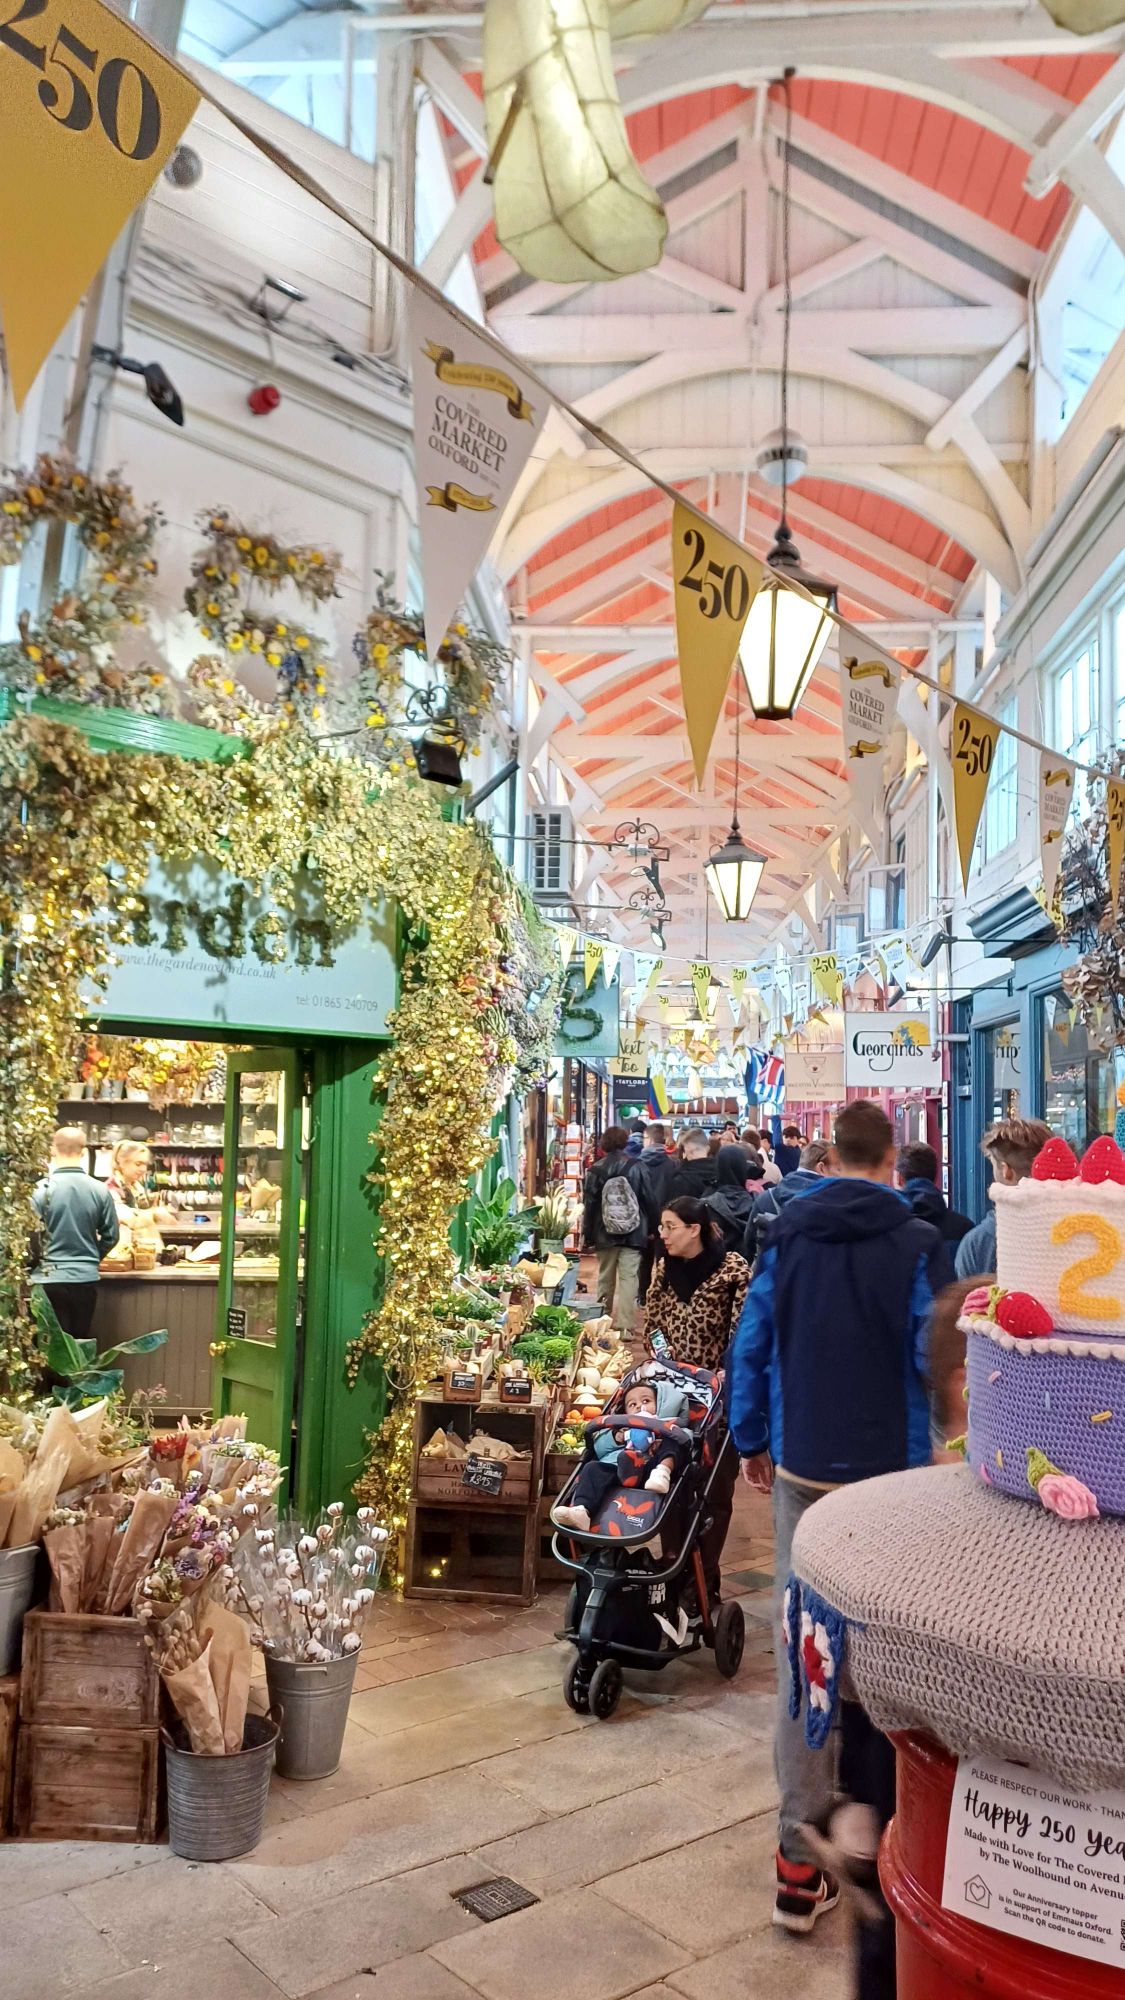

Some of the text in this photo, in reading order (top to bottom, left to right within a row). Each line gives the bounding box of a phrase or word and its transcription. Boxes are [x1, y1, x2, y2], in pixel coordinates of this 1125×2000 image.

[0, 0, 161, 160] 250
[432, 412, 506, 472] MARKET
[435, 394, 508, 452] COVERED
[428, 434, 479, 474] OXFORD
[679, 528, 750, 622] 250
[849, 700, 884, 725] MARKET
[850, 688, 885, 712] COVERED
[956, 718, 993, 776] 250
[1111, 788, 1125, 832] 25
[586, 942, 603, 958] 250
[691, 963, 711, 980] 250
[811, 955, 837, 973] 250
[312, 995, 342, 1009] 01865
[344, 998, 378, 1012] 240709
[617, 1056, 640, 1073] Too
[618, 1039, 645, 1056] Next
[1050, 1211, 1122, 1320] 2
[971, 1768, 998, 1785] PLEASE
[1000, 1778, 1037, 1797] RESPECT
[1040, 1790, 1060, 1804] OUR
[1062, 1797, 1092, 1812] WORK
[964, 1787, 1032, 1838] Happy
[1039, 1815, 1076, 1843] 250
[964, 1826, 987, 1843] Made
[989, 1837, 1010, 1851] with
[1012, 1843, 1034, 1859] Love
[1037, 1851, 1052, 1864] for
[1054, 1856, 1075, 1871] The
[1077, 1863, 1120, 1884] Covered
[979, 1847, 1125, 1900] by The Woolhound on Avenu
[998, 1893, 1114, 1936] is in support of Emmaus Oxford.
[1012, 1888, 1098, 1920] Our Anniversary topper
[1004, 1907, 1107, 1945] Scan the QR code to donate.
